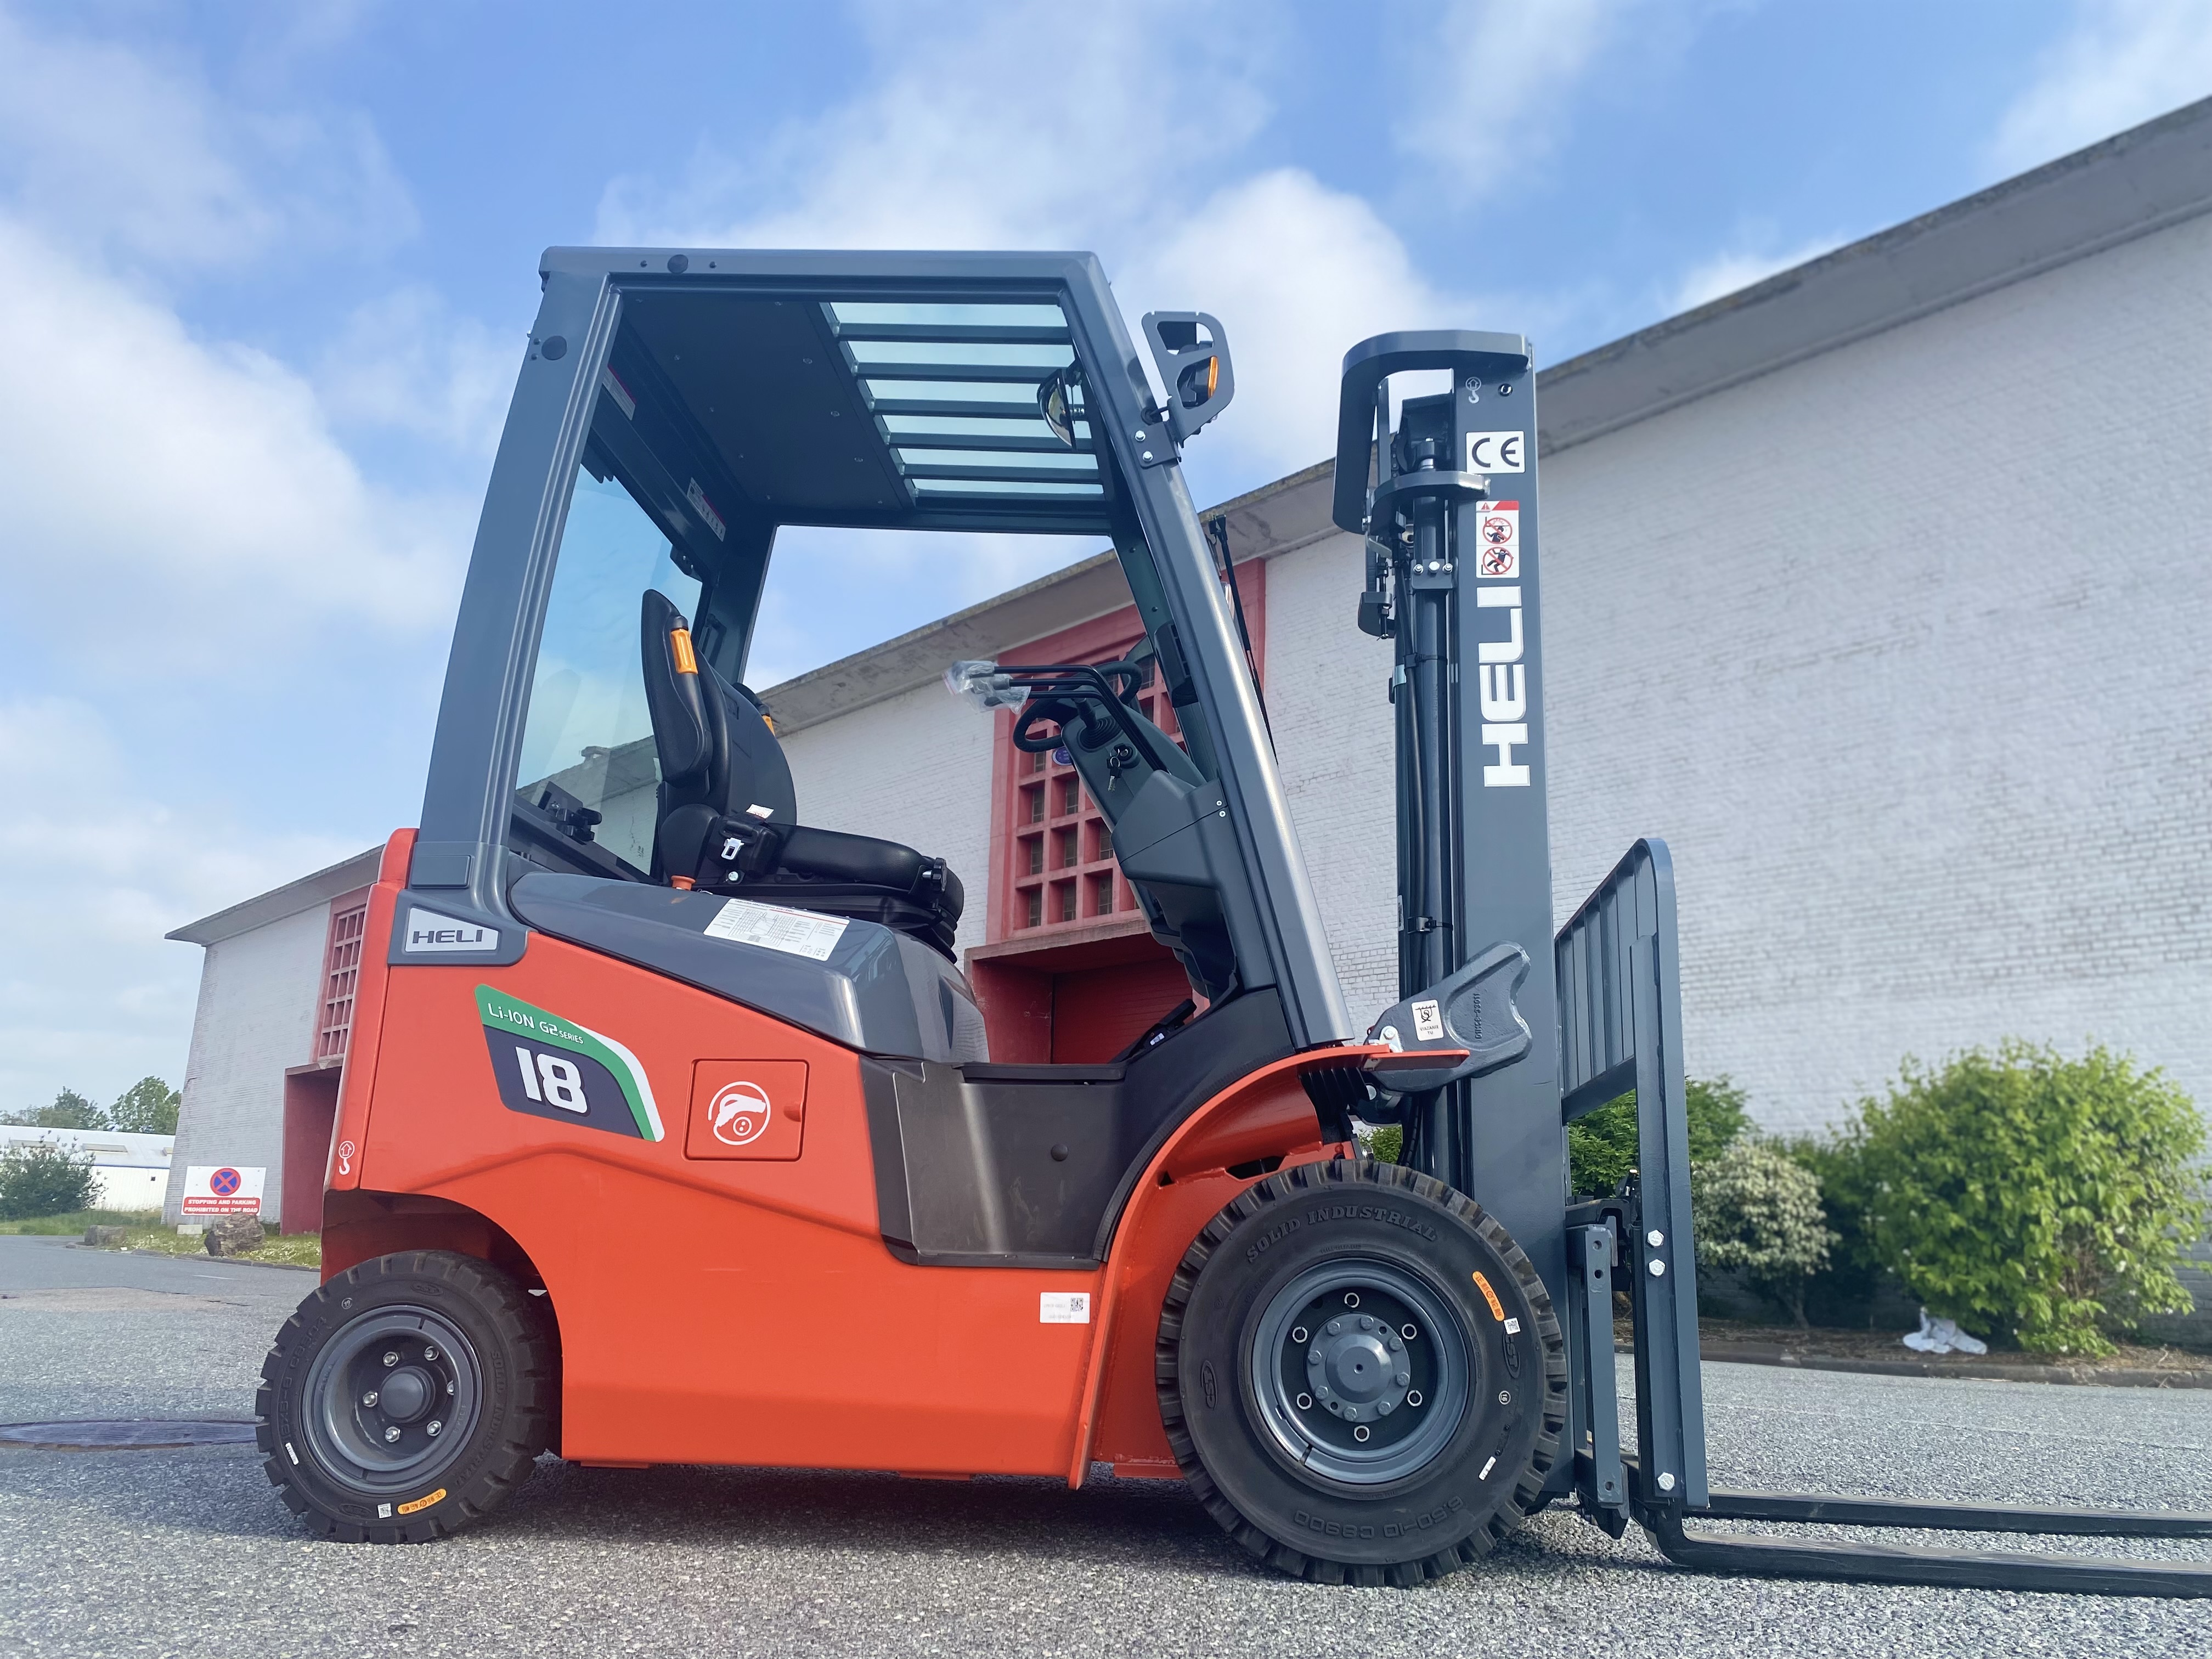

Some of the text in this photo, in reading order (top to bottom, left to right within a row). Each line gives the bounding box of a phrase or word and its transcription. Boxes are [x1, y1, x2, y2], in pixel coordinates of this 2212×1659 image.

[1471, 437, 1519, 468] CE
[1477, 586, 1531, 787] HELI
[413, 929, 483, 944] HELI
[488, 1003, 583, 1044] Li-ION G2 SERIES
[516, 1046, 588, 1113] 18
[1246, 1206, 1437, 1262] SOLID INDUSTRIAL
[1502, 1393, 1508, 1402] 16
